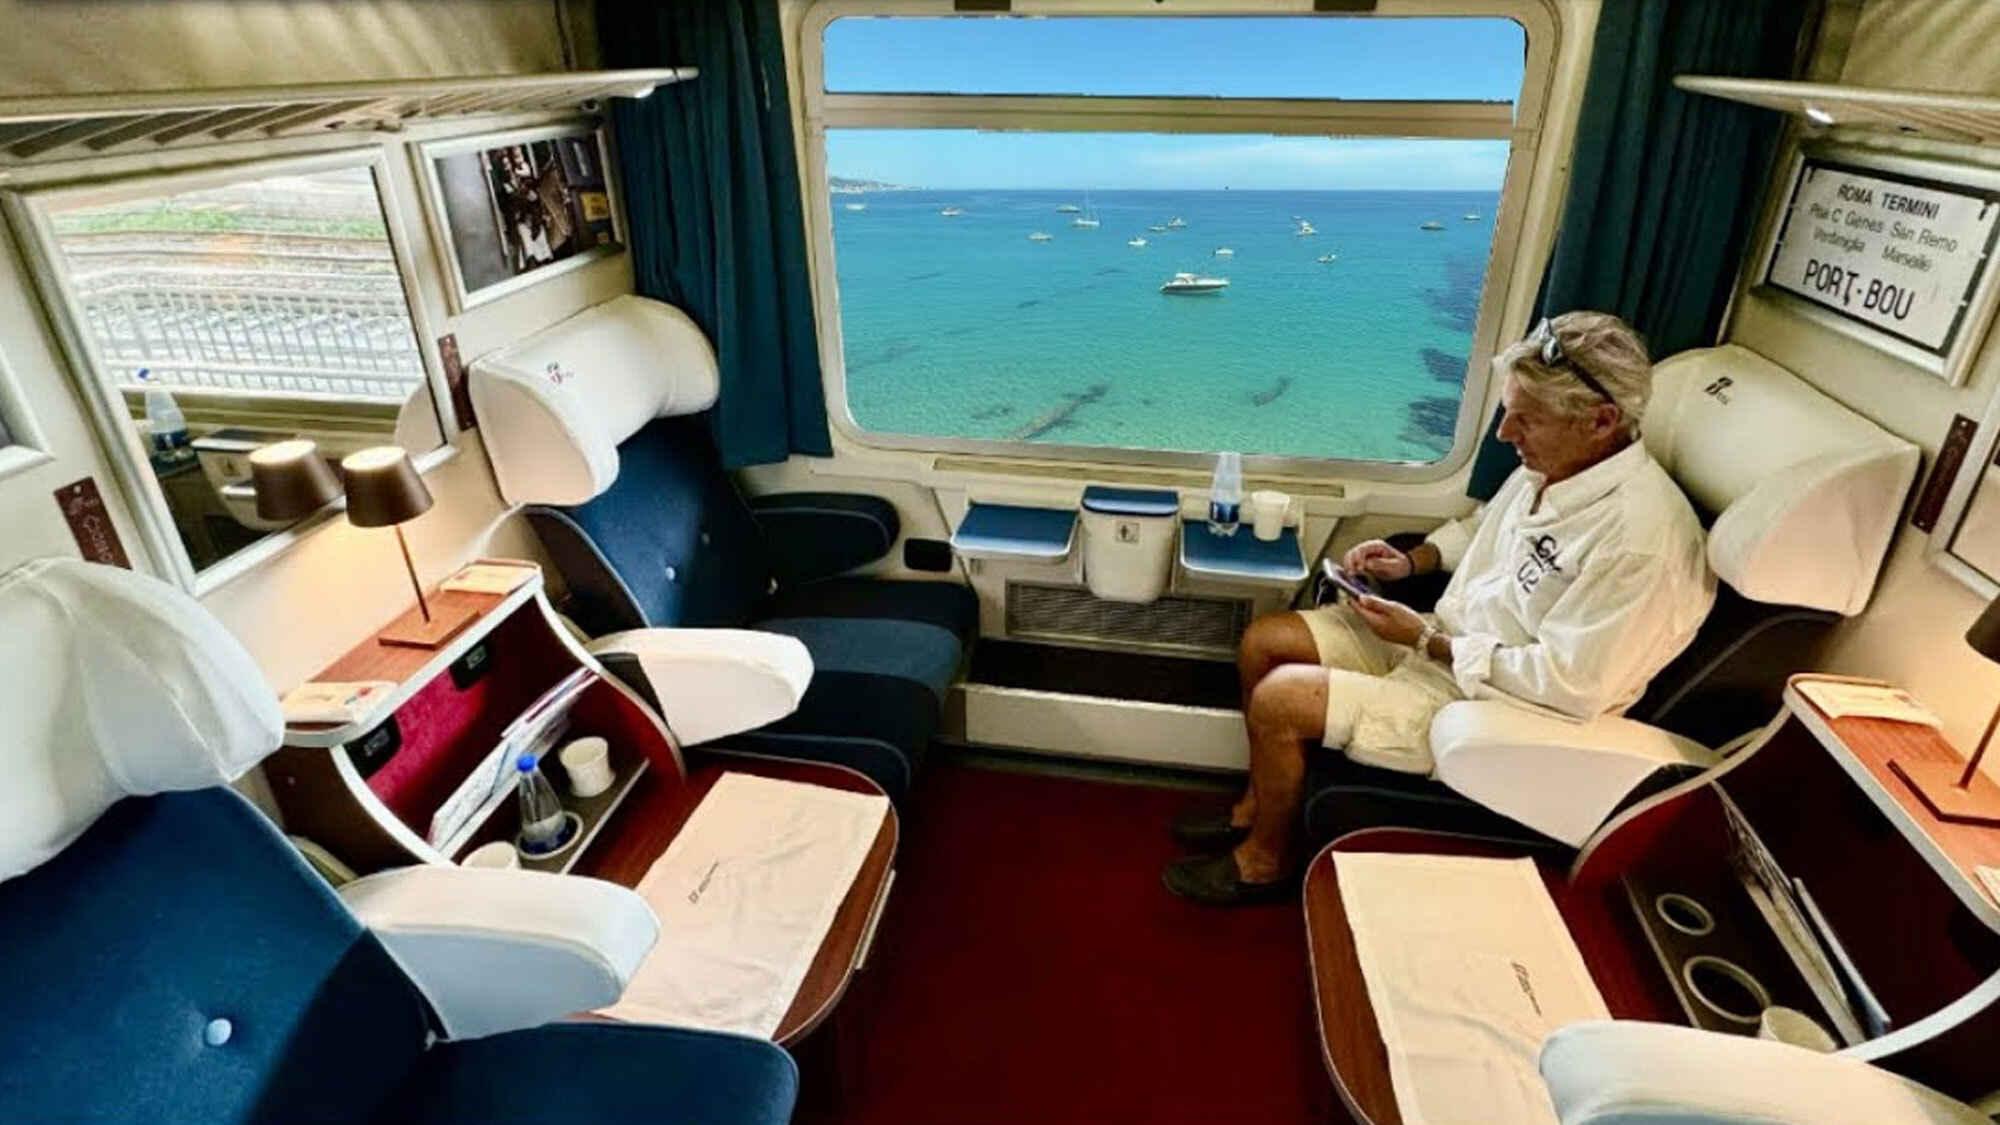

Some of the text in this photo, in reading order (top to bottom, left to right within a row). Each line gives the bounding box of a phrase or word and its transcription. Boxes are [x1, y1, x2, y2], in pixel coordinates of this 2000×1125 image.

[1837, 184, 1940, 220] ROMA TERMINI
[1890, 221, 1915, 241] San
[1917, 228, 1959, 252] Remo
